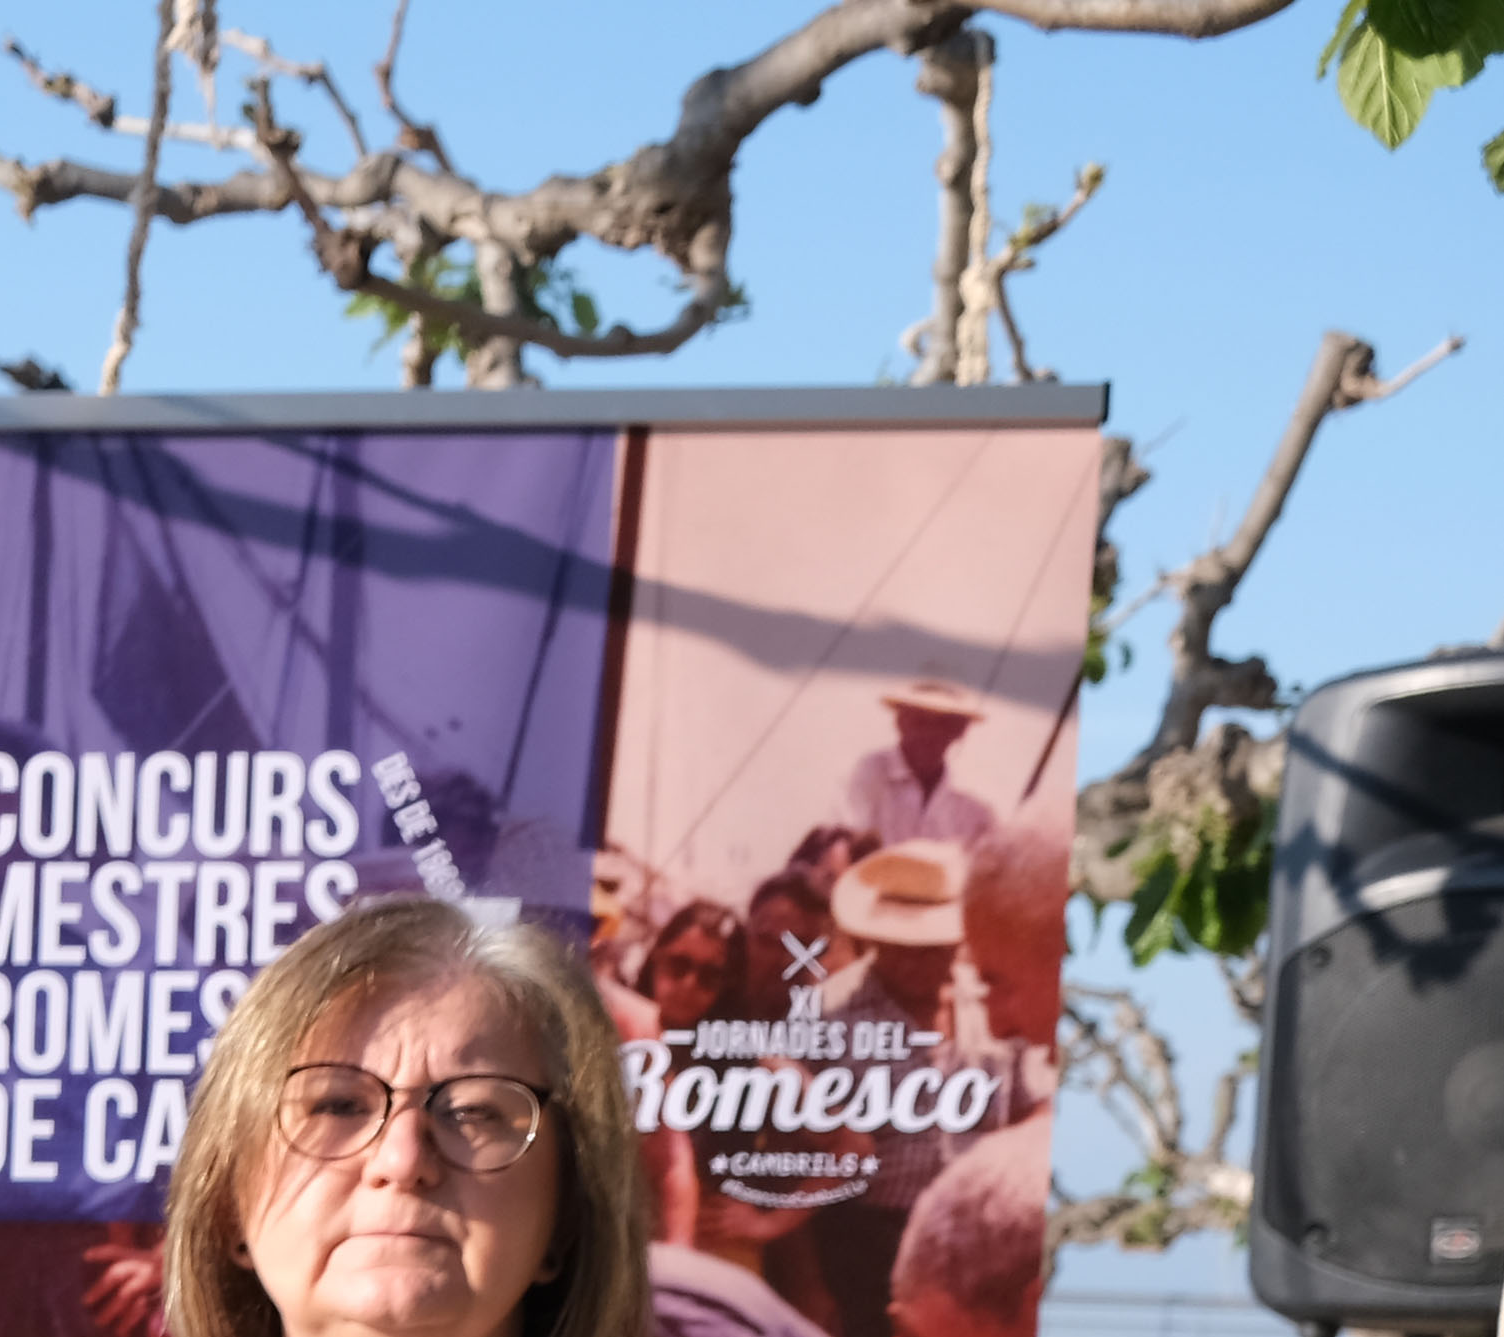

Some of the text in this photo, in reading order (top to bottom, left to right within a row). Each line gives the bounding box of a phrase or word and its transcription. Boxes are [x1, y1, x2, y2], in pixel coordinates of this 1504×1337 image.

[392, 799, 438, 845] DE
[789, 985, 822, 1020] XI
[692, 1019, 911, 1060] JORNADES DEL
[619, 1039, 1002, 1133] Romesco
[730, 1152, 858, 1178] CAMBRILS
